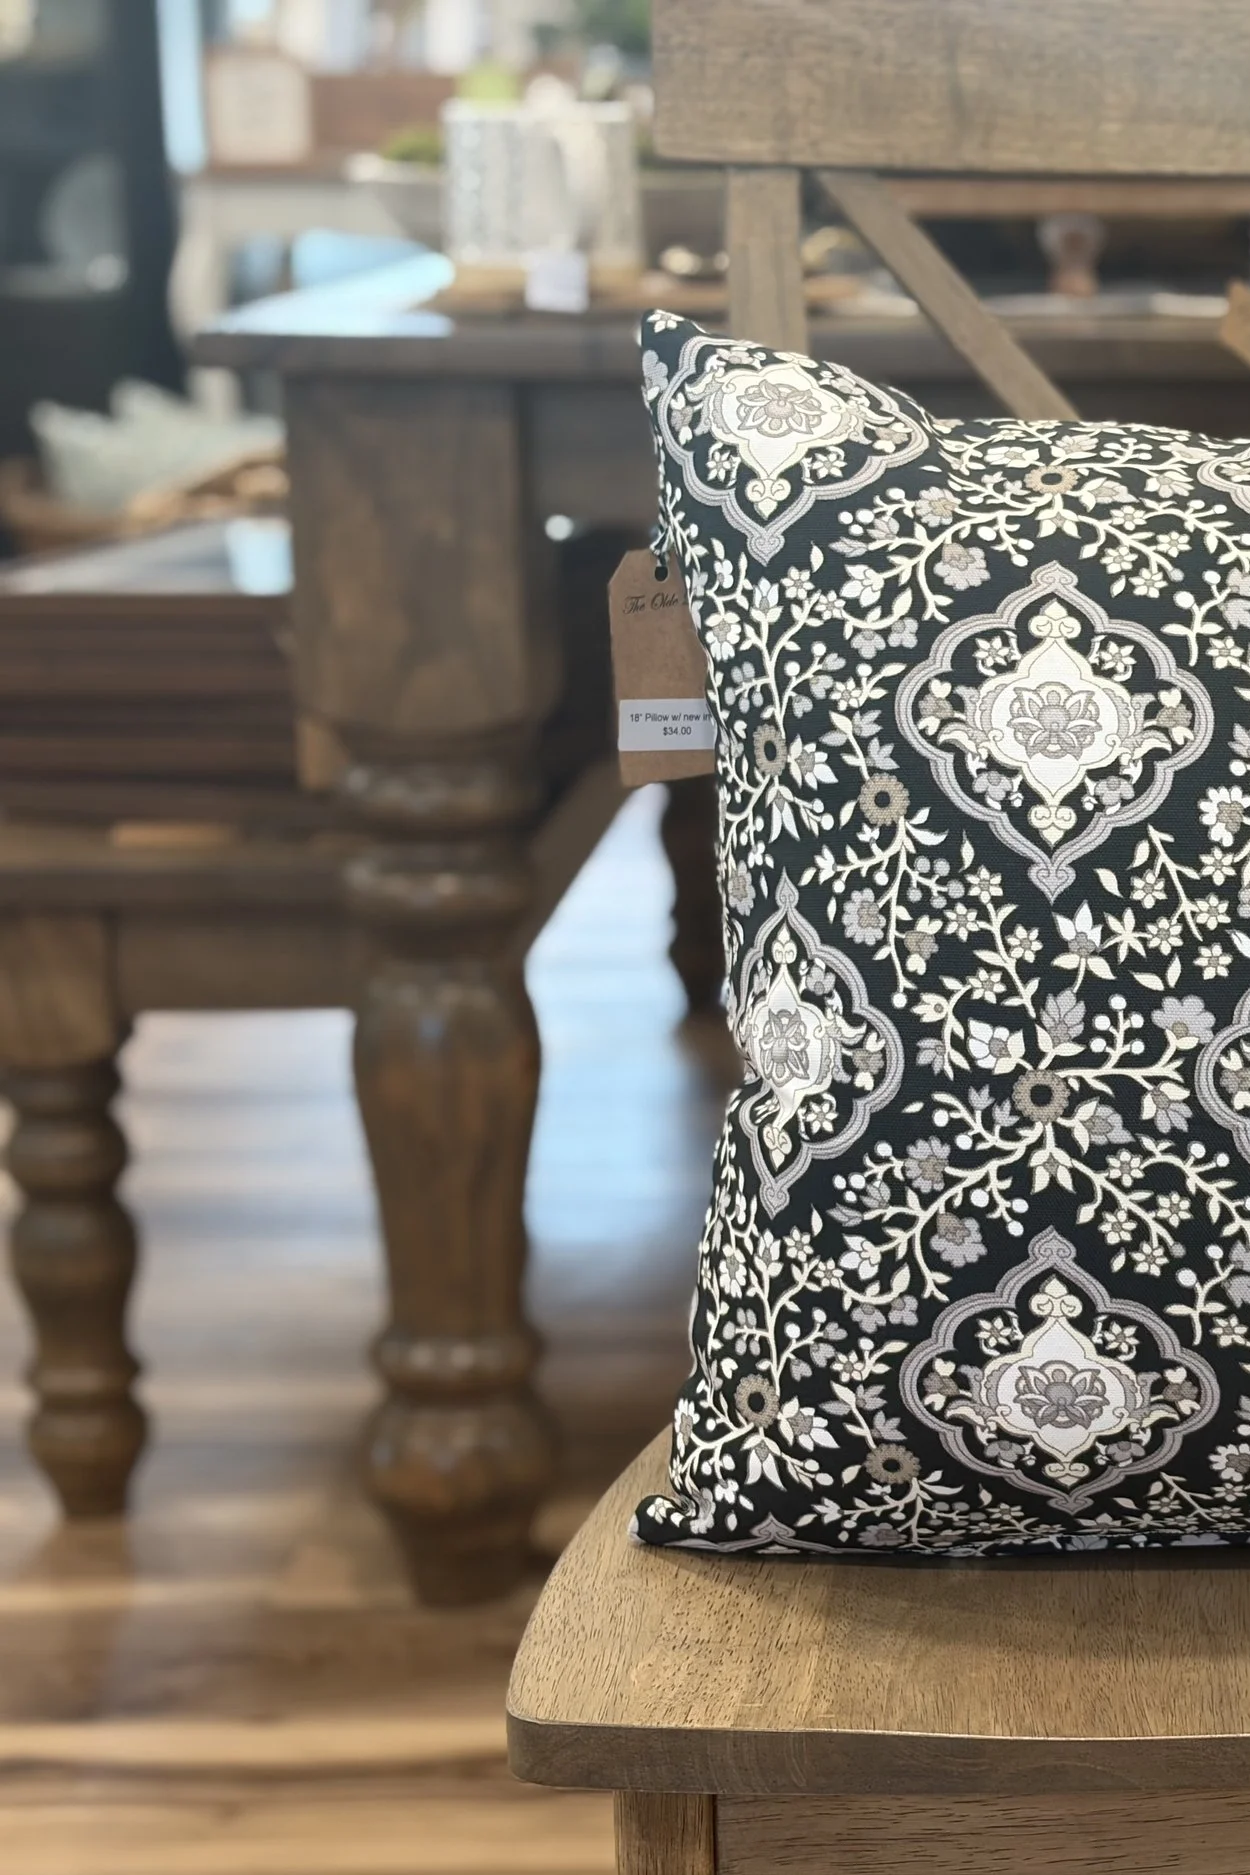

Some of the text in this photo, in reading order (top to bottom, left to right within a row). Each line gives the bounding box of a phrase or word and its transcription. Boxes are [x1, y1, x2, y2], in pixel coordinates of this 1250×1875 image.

[621, 592, 679, 614] The Olde
[630, 713, 643, 723] 18"
[645, 713, 669, 722] Pillow
[671, 713, 682, 722] w/
[683, 713, 701, 722] new
[663, 727, 692, 736] $34.00
